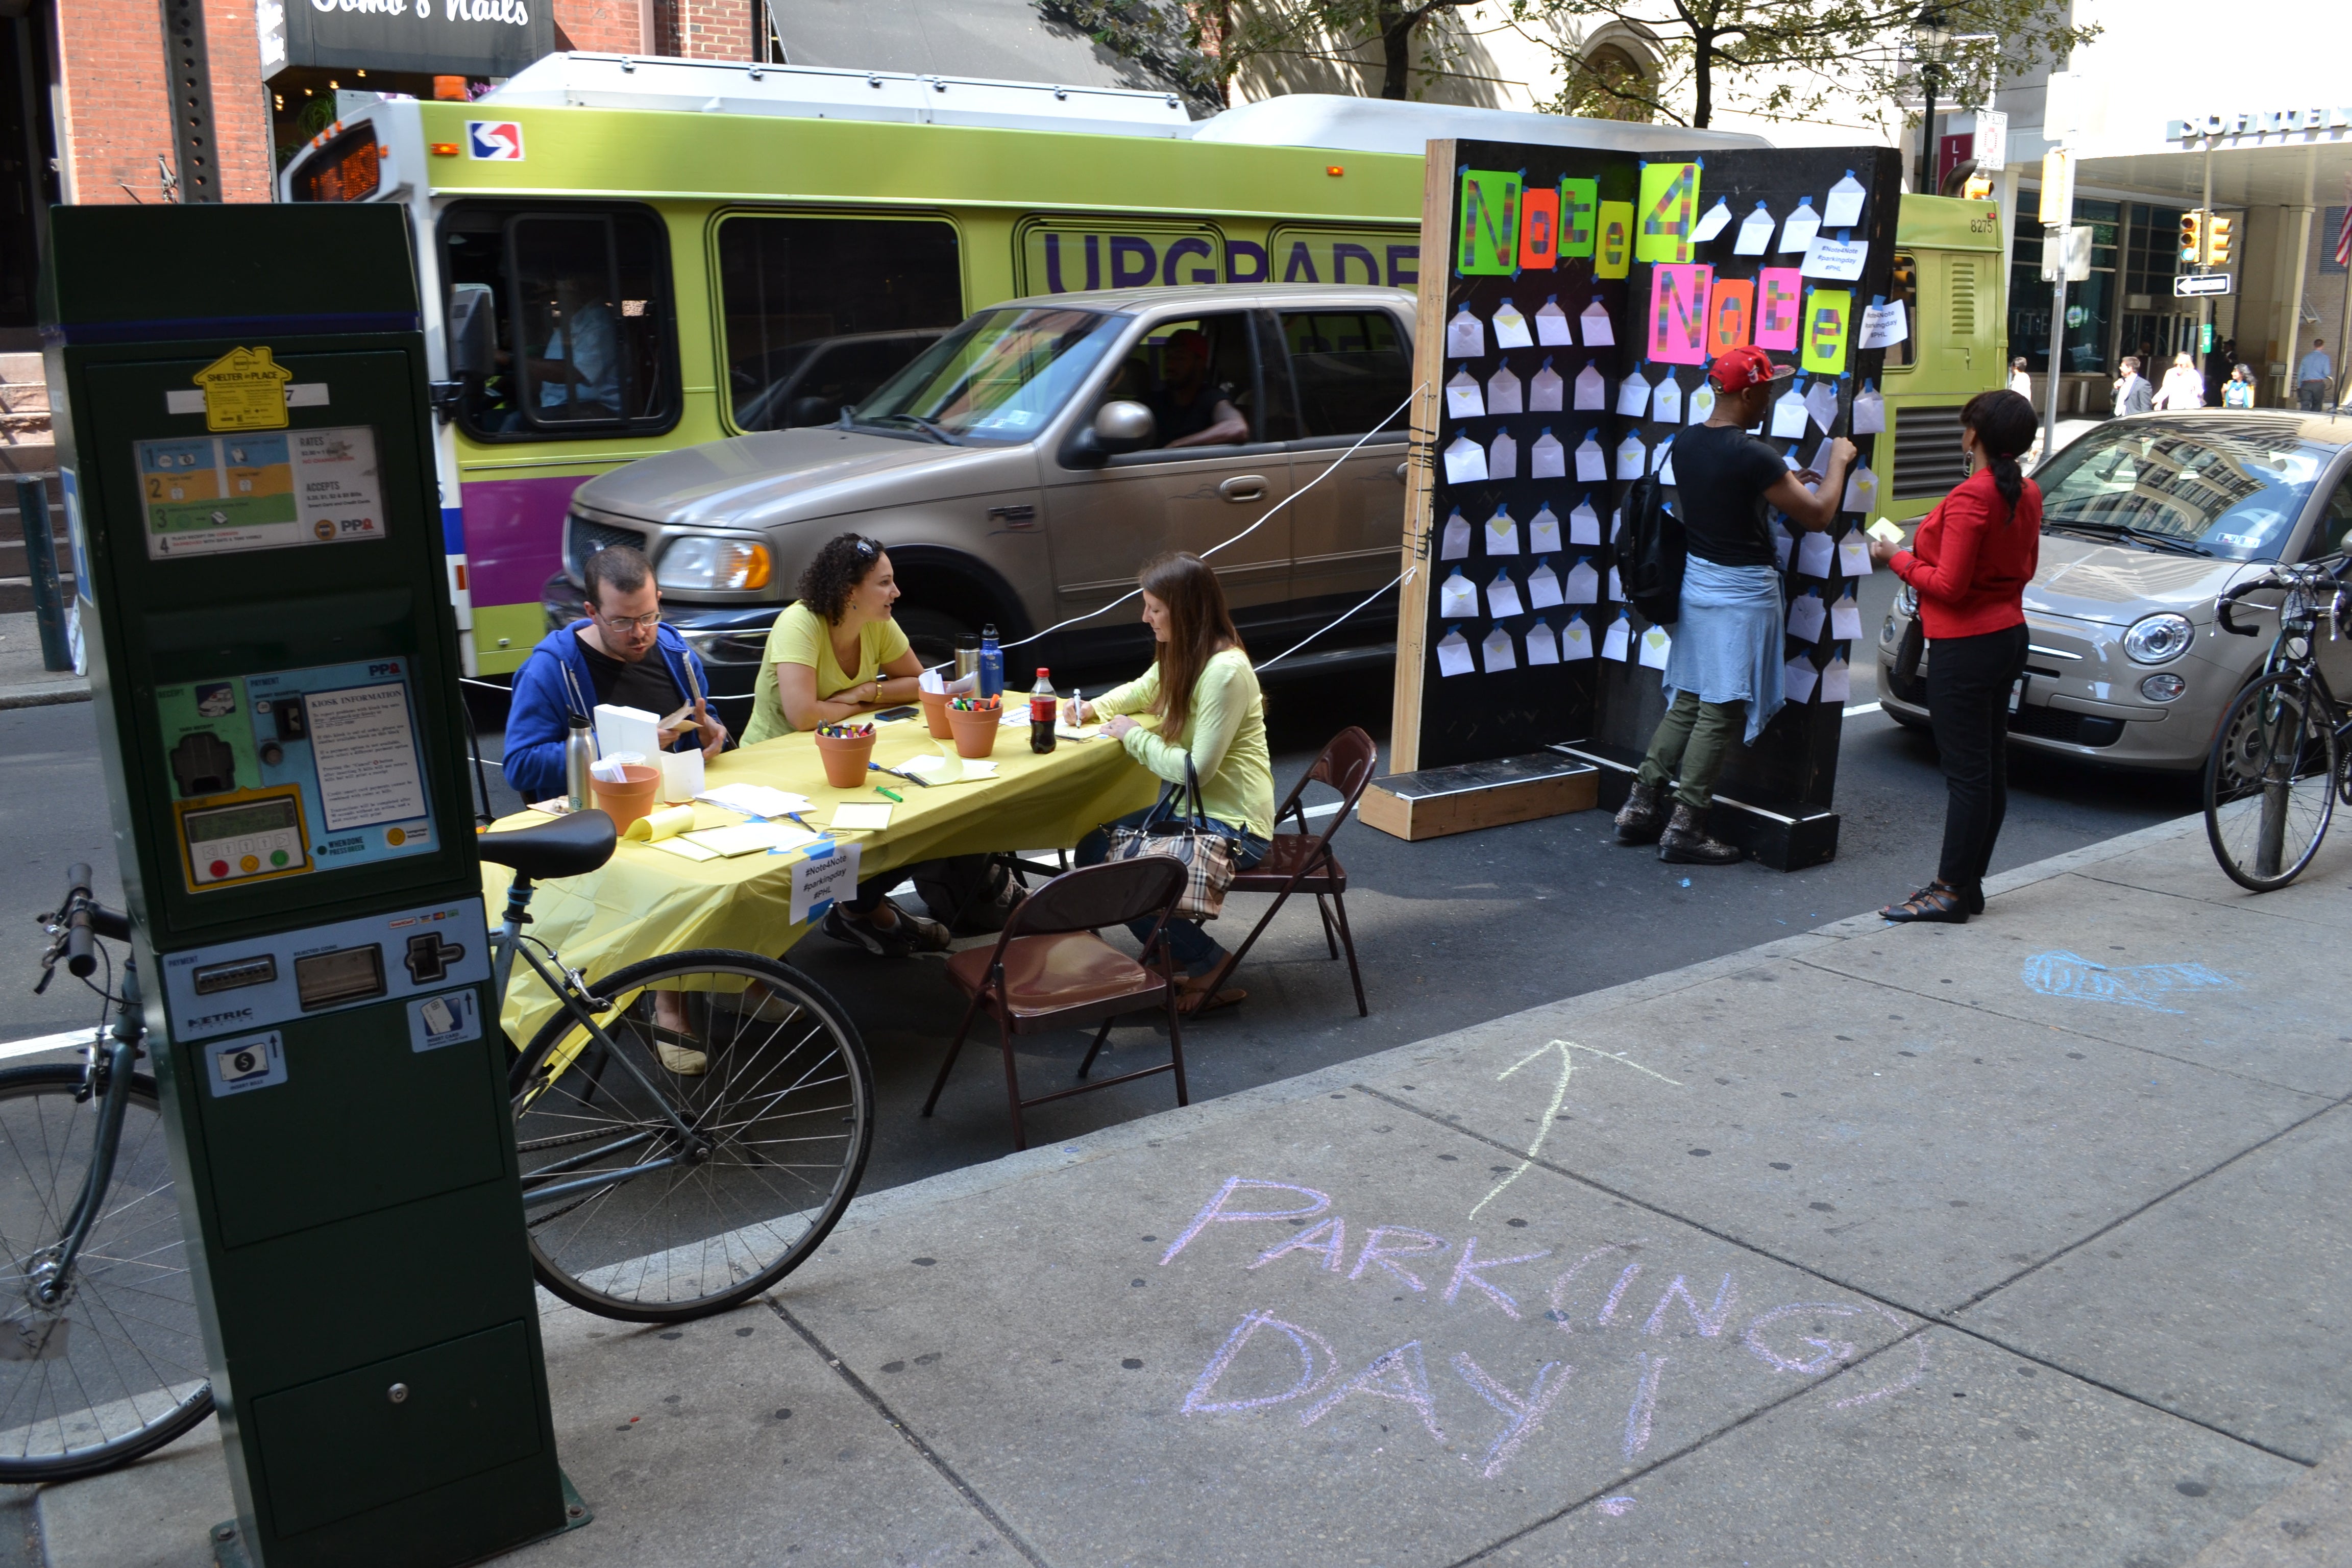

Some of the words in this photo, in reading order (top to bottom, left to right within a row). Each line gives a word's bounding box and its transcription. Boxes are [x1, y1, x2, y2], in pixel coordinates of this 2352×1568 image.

[1464, 179, 1624, 266] Note
[1644, 165, 1695, 262] 4
[1971, 219, 1993, 233] 8275
[1822, 245, 1858, 254] #Note4Note
[1818, 255, 1857, 264] #parkingday
[1657, 270, 1841, 358] Note
[208, 373, 243, 382] SHELTER
[251, 371, 278, 380] PLACE
[300, 437, 324, 447] RATES
[146, 448, 154, 468] 1
[151, 479, 162, 498] 2
[306, 481, 340, 492] ACCEPTS
[156, 509, 167, 528] 3
[160, 537, 169, 552] 4
[250, 677, 279, 687] PAYMENT
[311, 698, 338, 707] KIOSK
[341, 690, 402, 704] INFORMATION
[329, 840, 346, 848] WHEN
[347, 836, 363, 845] DONE
[329, 847, 348, 855] PRESS
[348, 844, 365, 852] GREEN
[805, 855, 846, 877] #Note4Note
[803, 868, 847, 892] #parkingday
[814, 886, 831, 900] #PHL
[294, 948, 320, 957] REJECTED
[168, 956, 198, 967] PAYMENT
